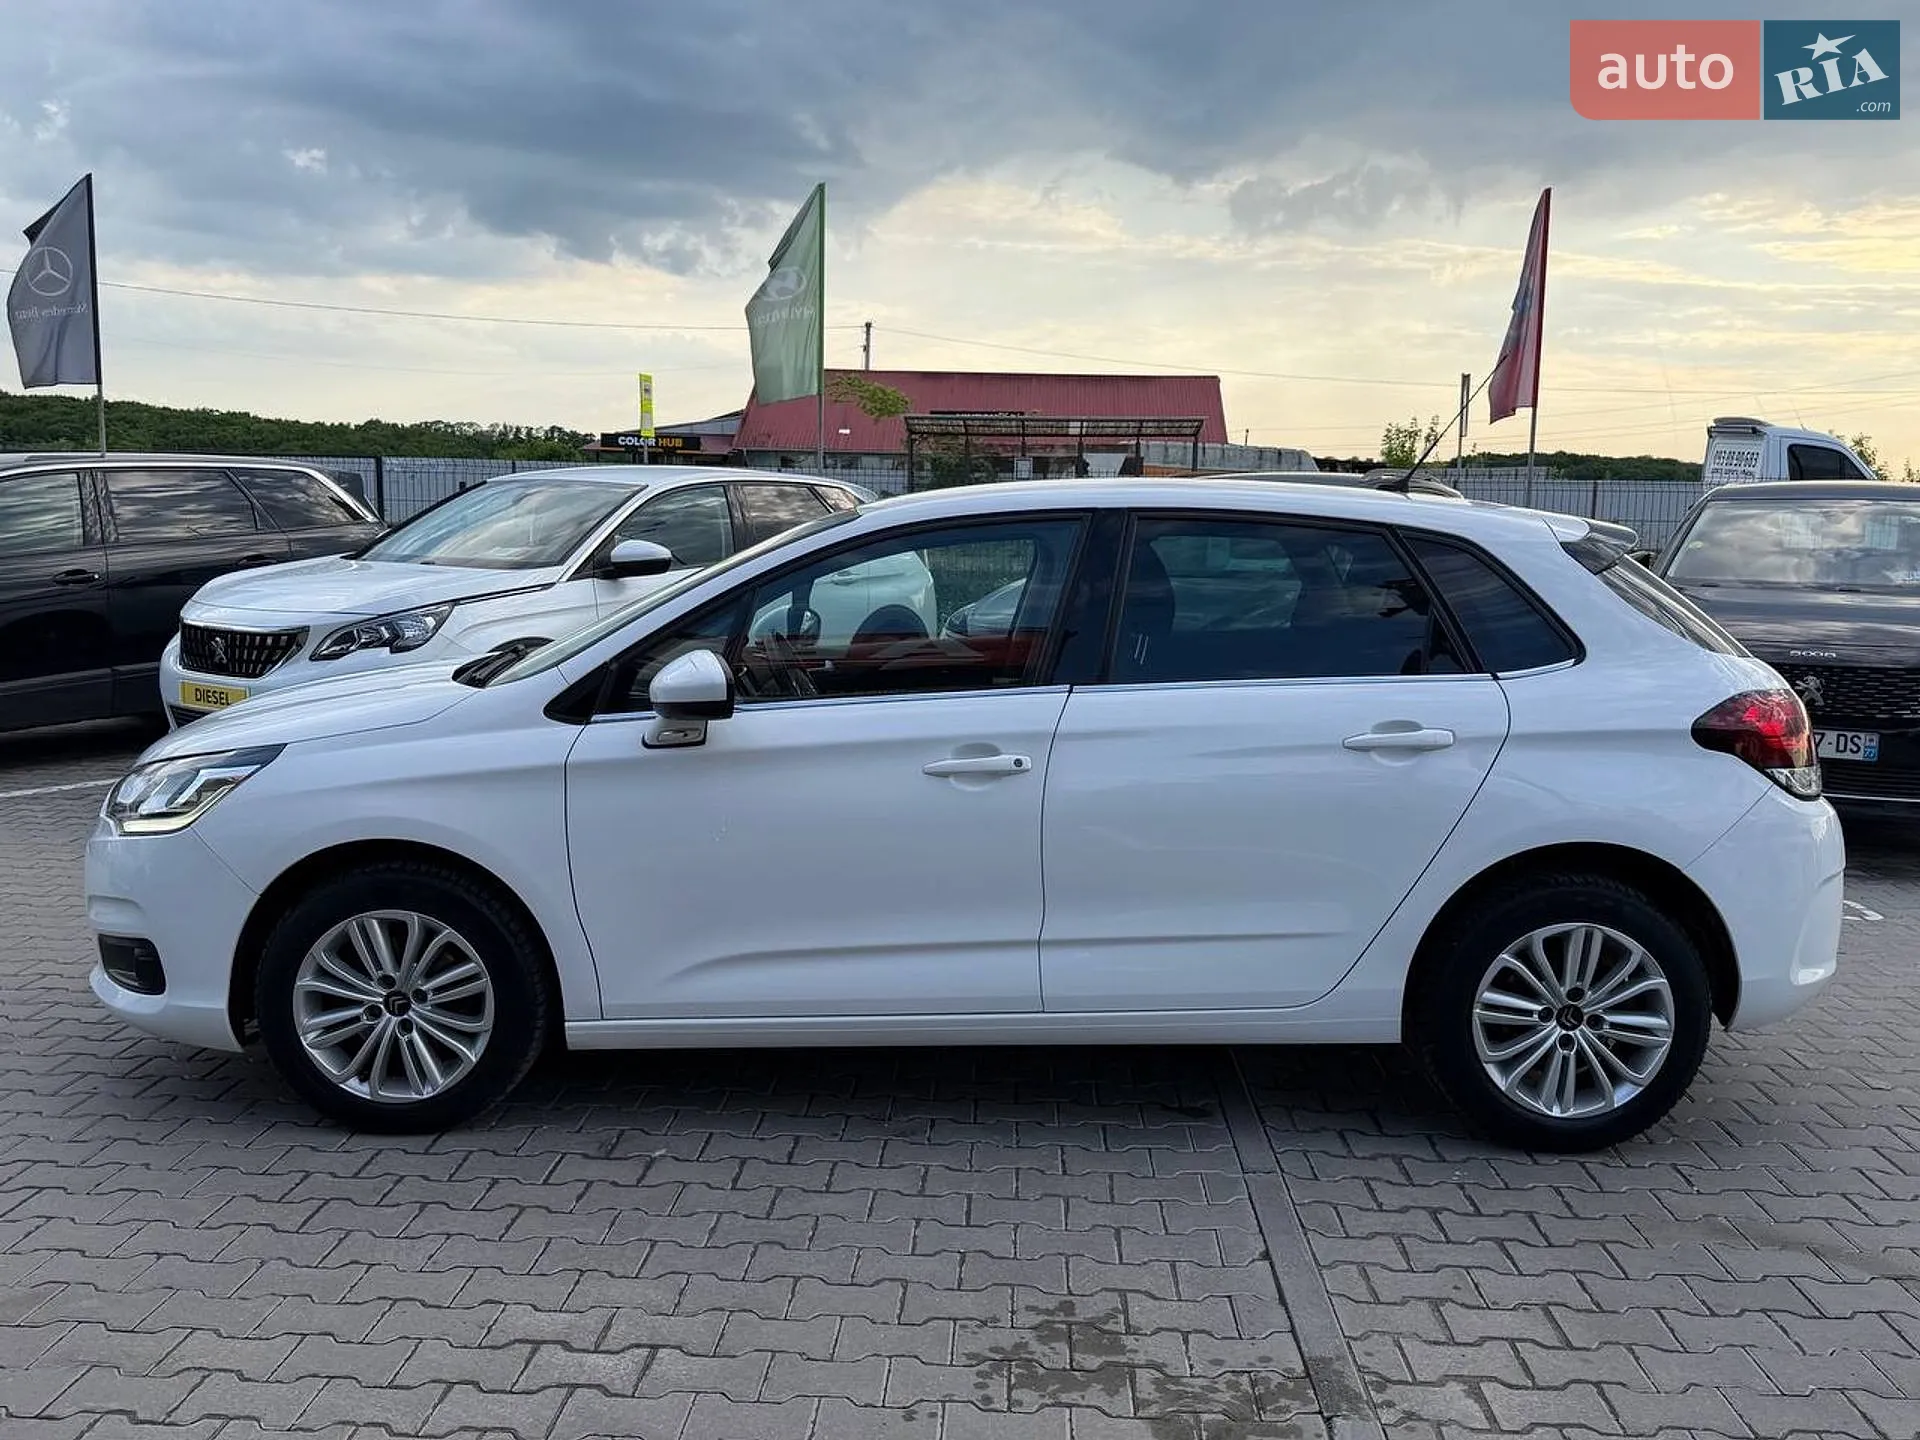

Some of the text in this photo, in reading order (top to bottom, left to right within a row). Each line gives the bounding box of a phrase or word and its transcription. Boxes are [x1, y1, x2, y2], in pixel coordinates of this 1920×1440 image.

[618, 436, 683, 448] COLOR HUB
[195, 687, 231, 706] DIESEL
